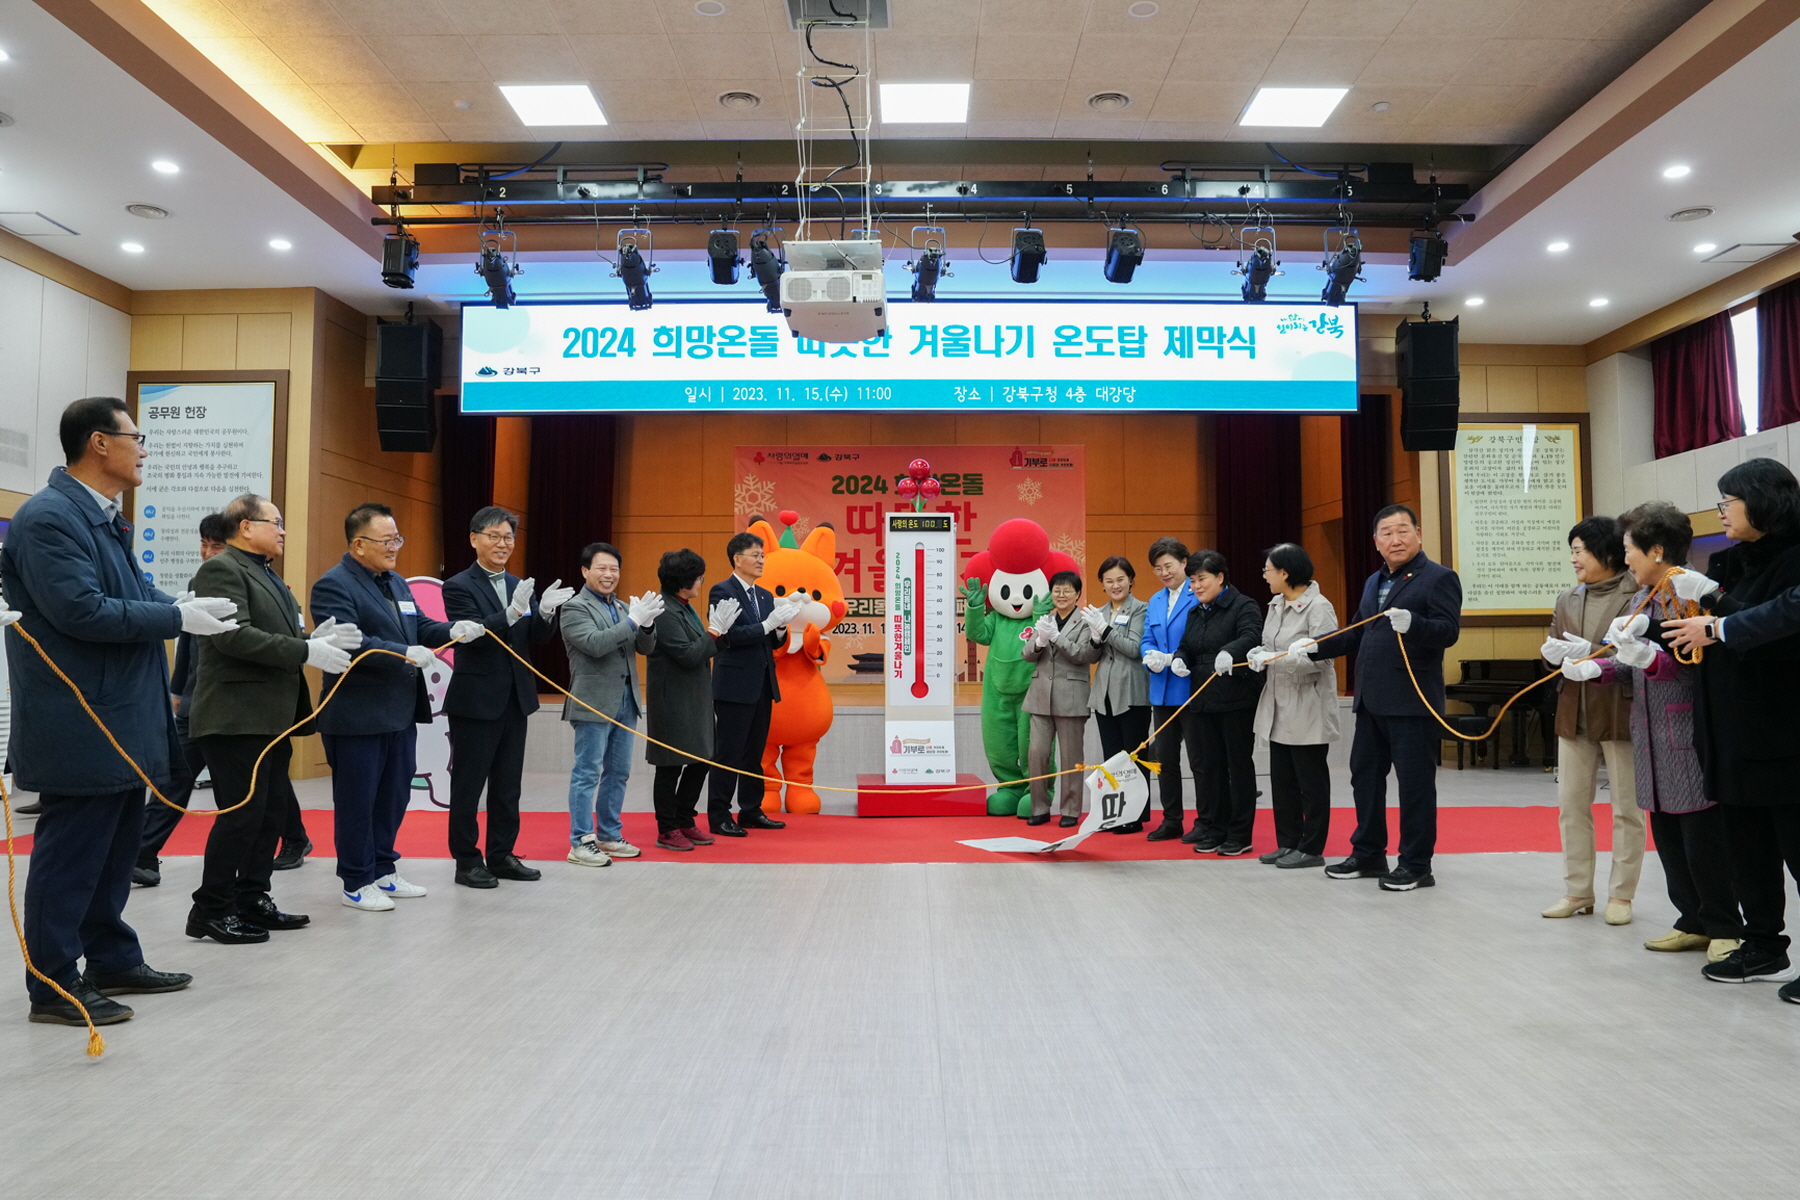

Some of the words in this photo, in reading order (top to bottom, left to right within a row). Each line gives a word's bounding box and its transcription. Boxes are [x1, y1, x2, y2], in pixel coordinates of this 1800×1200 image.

[409, 189, 414, 199] 1
[500, 187, 506, 198] 2
[687, 186, 692, 195] 1
[782, 185, 788, 195] 2
[876, 184, 882, 194] 3
[971, 184, 977, 194] 4
[1067, 185, 1073, 194] 5
[1161, 185, 1168, 194] 6
[1254, 186, 1259, 195] 4
[1308, 313, 1344, 339] 강북
[563, 327, 636, 358] 2024
[653, 325, 779, 359] 희망온돌
[910, 325, 1034, 358] 겨울나기
[1053, 325, 1148, 358] 온도탑
[1164, 325, 1255, 359] 제막식
[503, 367, 541, 376] 강북구
[685, 387, 711, 403] 일시
[733, 387, 767, 401] 2023.
[777, 387, 795, 401] 11.
[805, 387, 848, 402] 15.(수)
[858, 388, 892, 400] 11:00
[954, 387, 981, 402] 장소
[1003, 387, 1058, 402] 강북구청
[1066, 387, 1087, 402] 4층
[1096, 387, 1137, 402] 대강당
[148, 406, 180, 419] 공무원
[185, 406, 207, 419] 헌장
[1024, 458, 1047, 467] 기부로
[831, 475, 888, 495] 2024
[892, 519, 907, 529] 사랑의
[908, 519, 919, 529] 온도
[943, 520, 949, 528] 도
[832, 623, 859, 634] 2023.
[863, 623, 875, 634] 11.
[903, 746, 925, 754] 기부로
